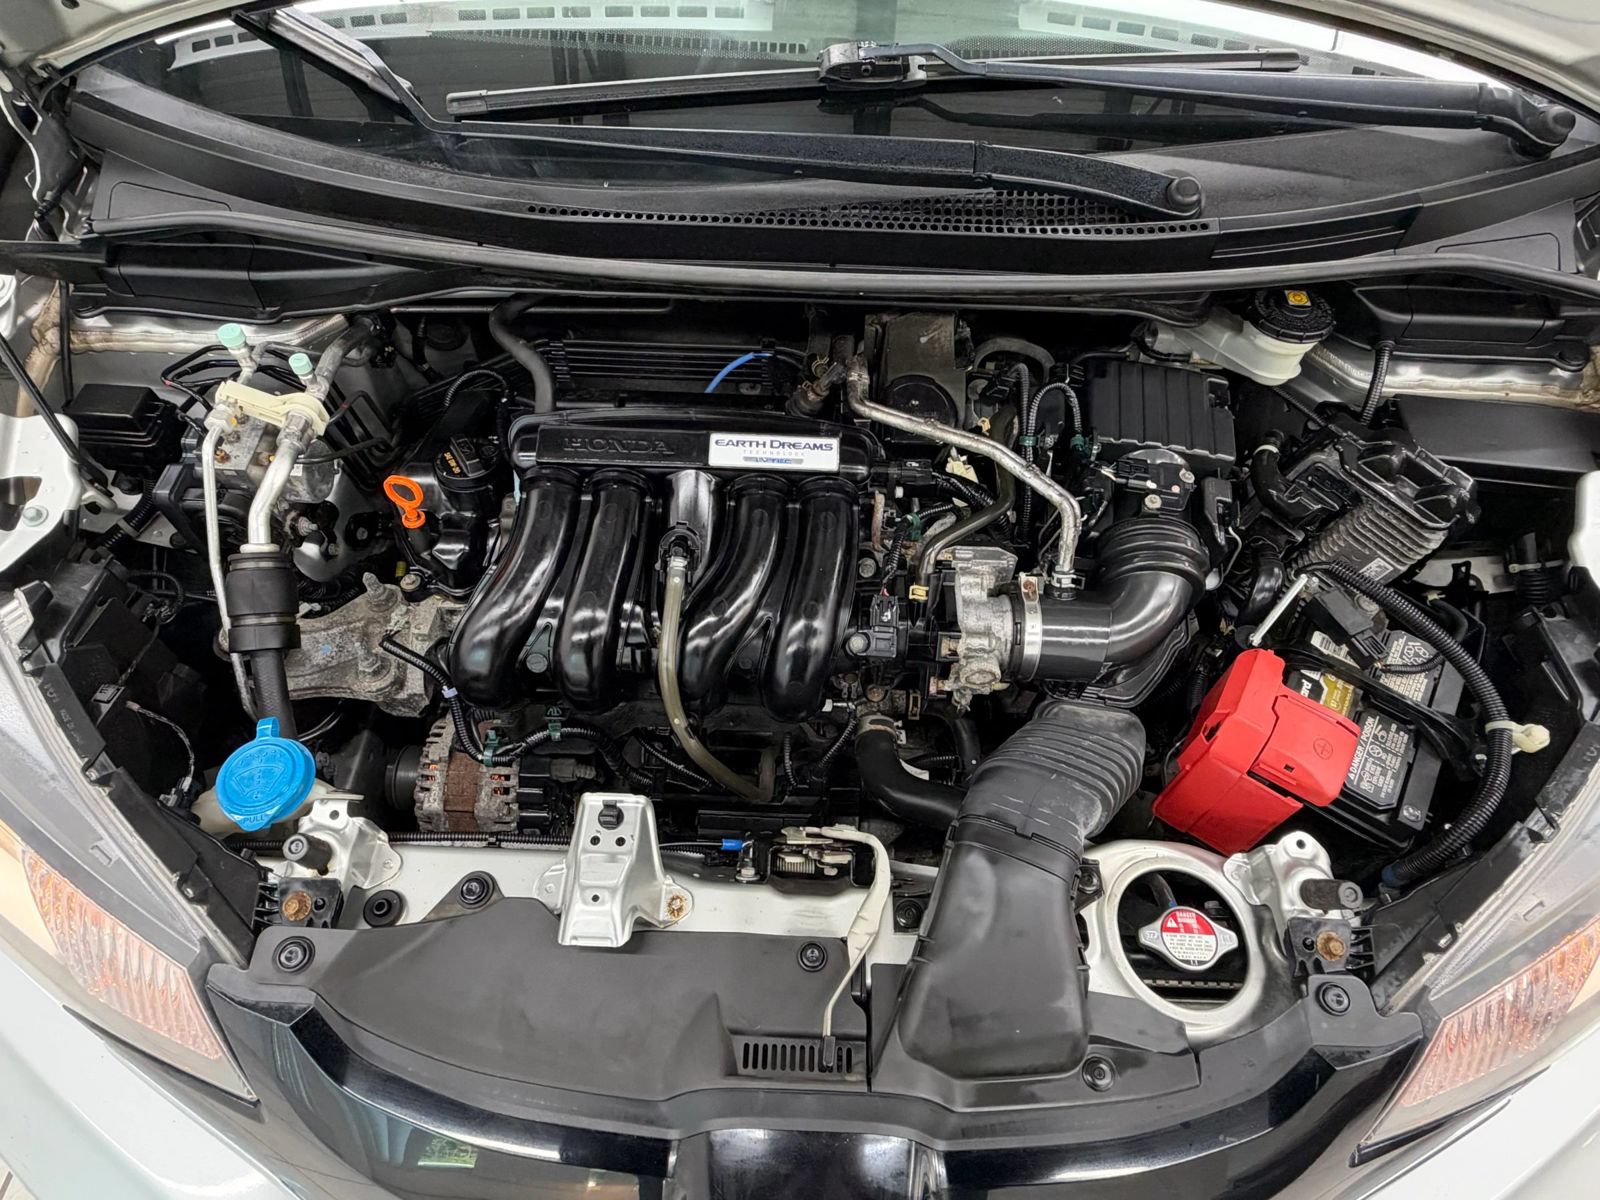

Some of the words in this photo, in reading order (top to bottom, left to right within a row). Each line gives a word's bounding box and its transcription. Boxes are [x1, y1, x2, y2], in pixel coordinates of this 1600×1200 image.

[563, 437, 676, 455] HONDA
[714, 439, 766, 449] EARTH
[769, 439, 834, 451] DREAMS
[1348, 745, 1365, 773] DANGER
[1361, 716, 1376, 741] POISON
[243, 814, 265, 824] PULL
